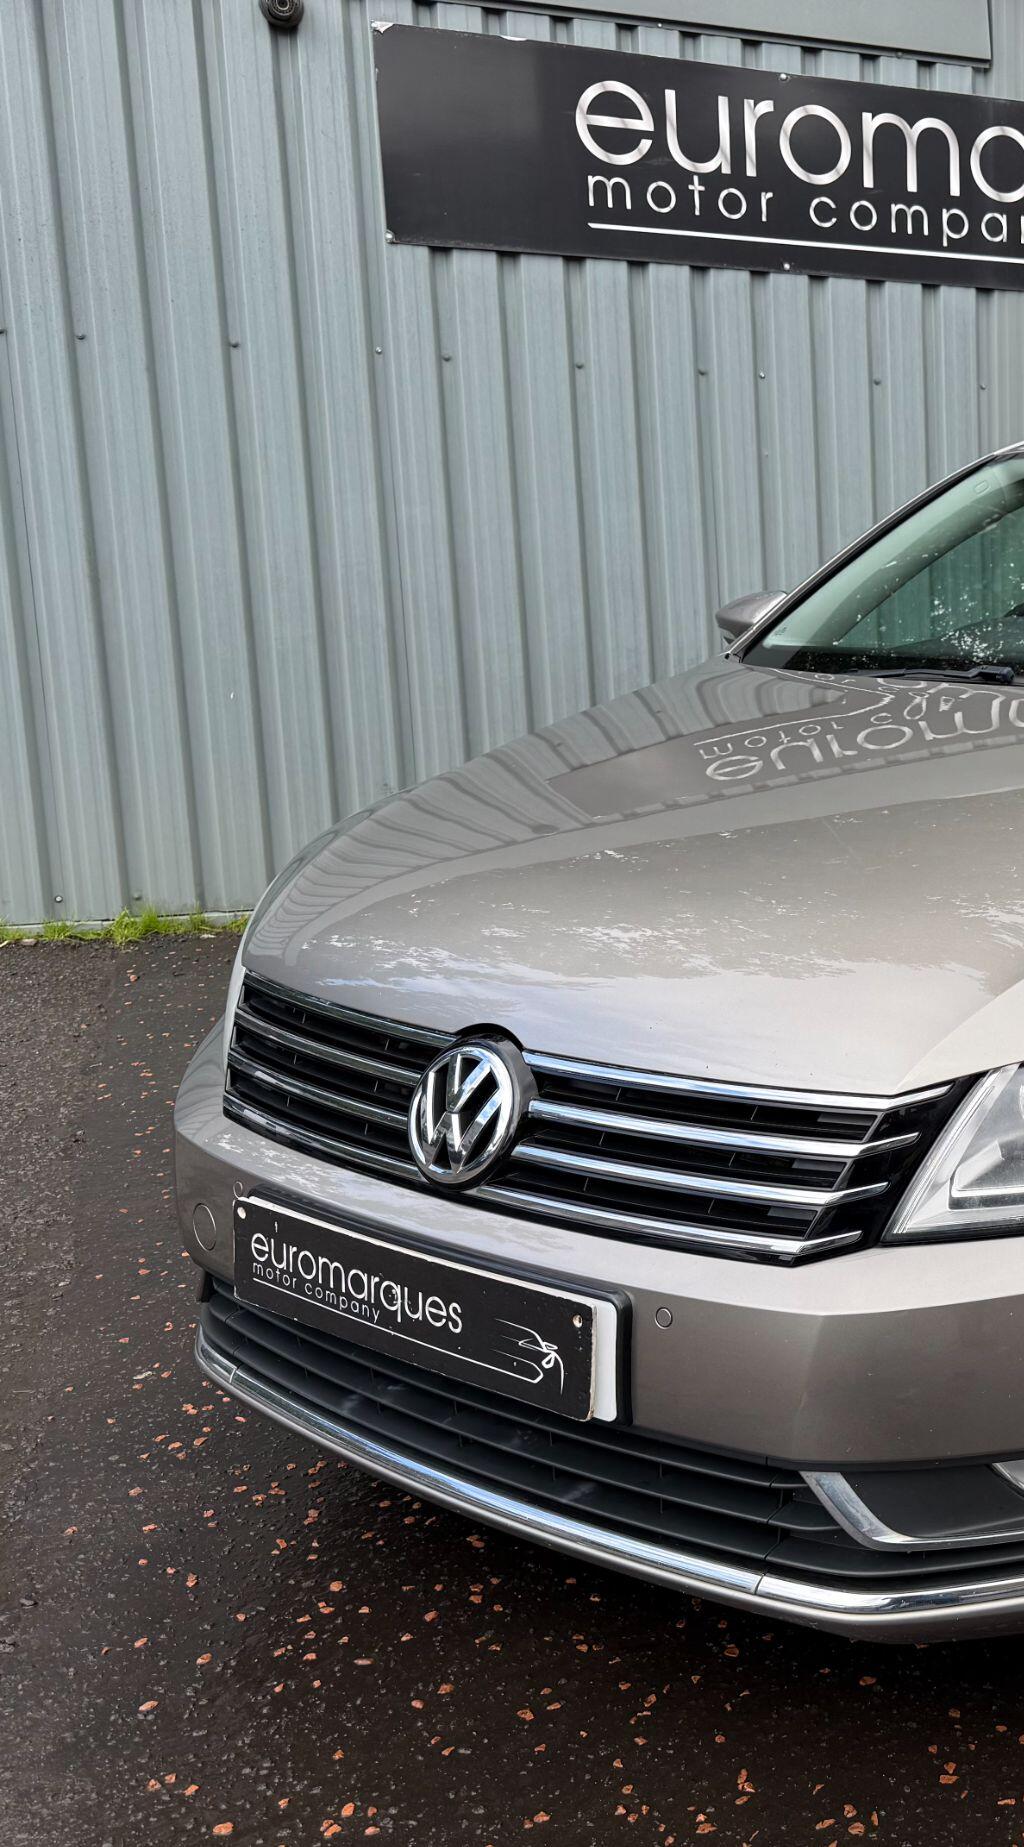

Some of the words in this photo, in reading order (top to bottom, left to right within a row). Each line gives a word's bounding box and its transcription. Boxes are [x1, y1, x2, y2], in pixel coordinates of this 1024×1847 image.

[587, 174, 775, 222] motor
[250, 1232, 463, 1334] euromarques
[252, 1261, 298, 1290] motor
[304, 1282, 381, 1325] company
